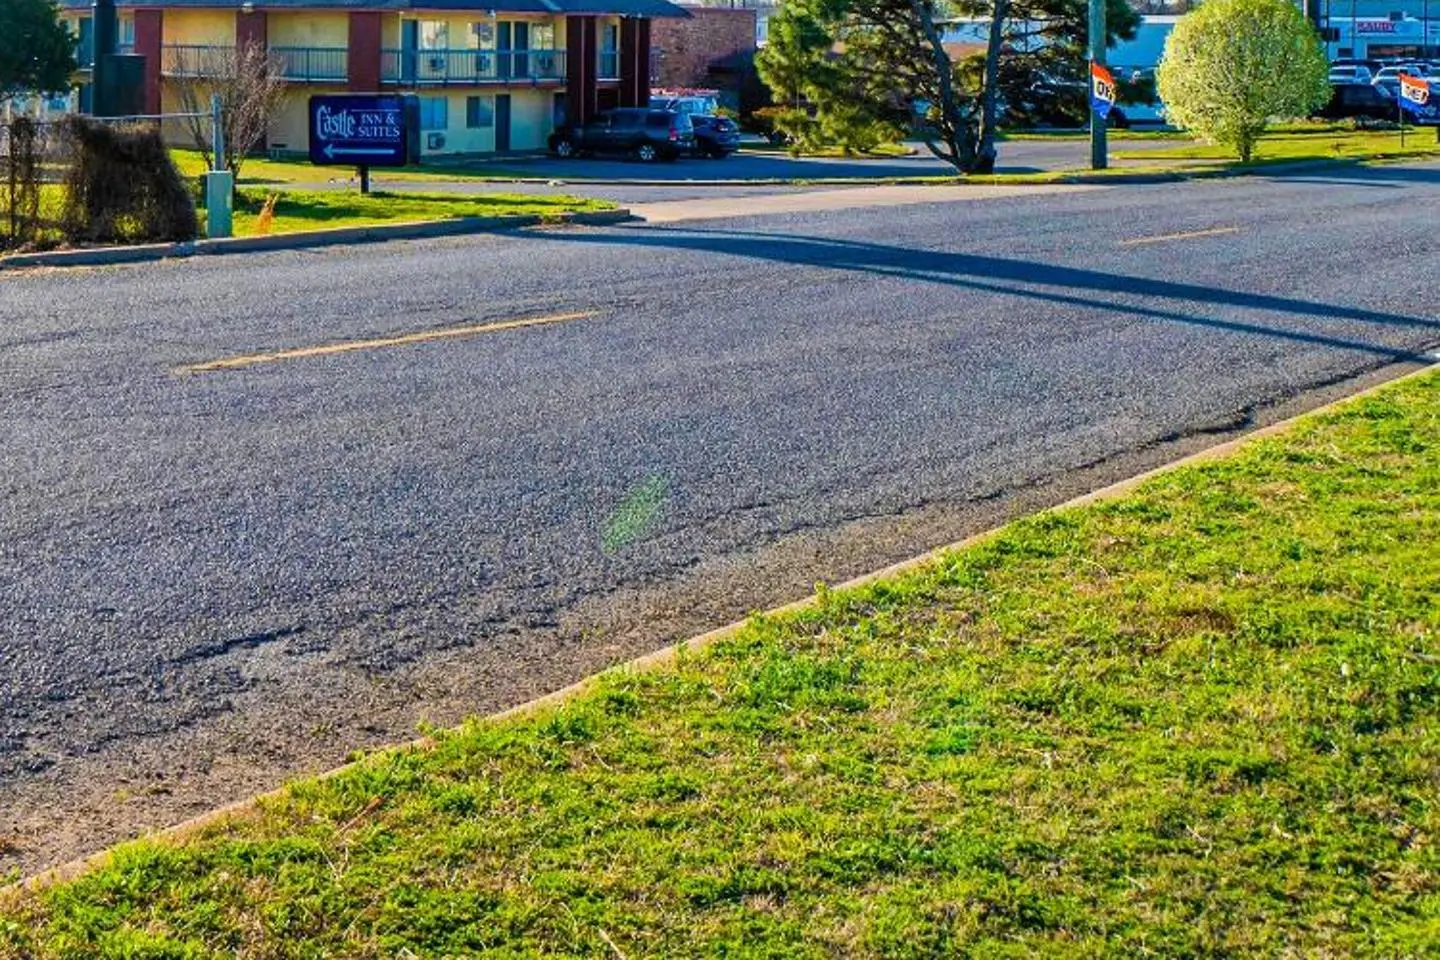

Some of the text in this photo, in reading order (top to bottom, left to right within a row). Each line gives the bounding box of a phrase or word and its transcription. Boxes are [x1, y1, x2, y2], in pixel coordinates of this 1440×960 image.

[316, 105, 357, 140] Castle
[361, 112, 397, 125] INN &
[358, 126, 400, 137] SUITES
